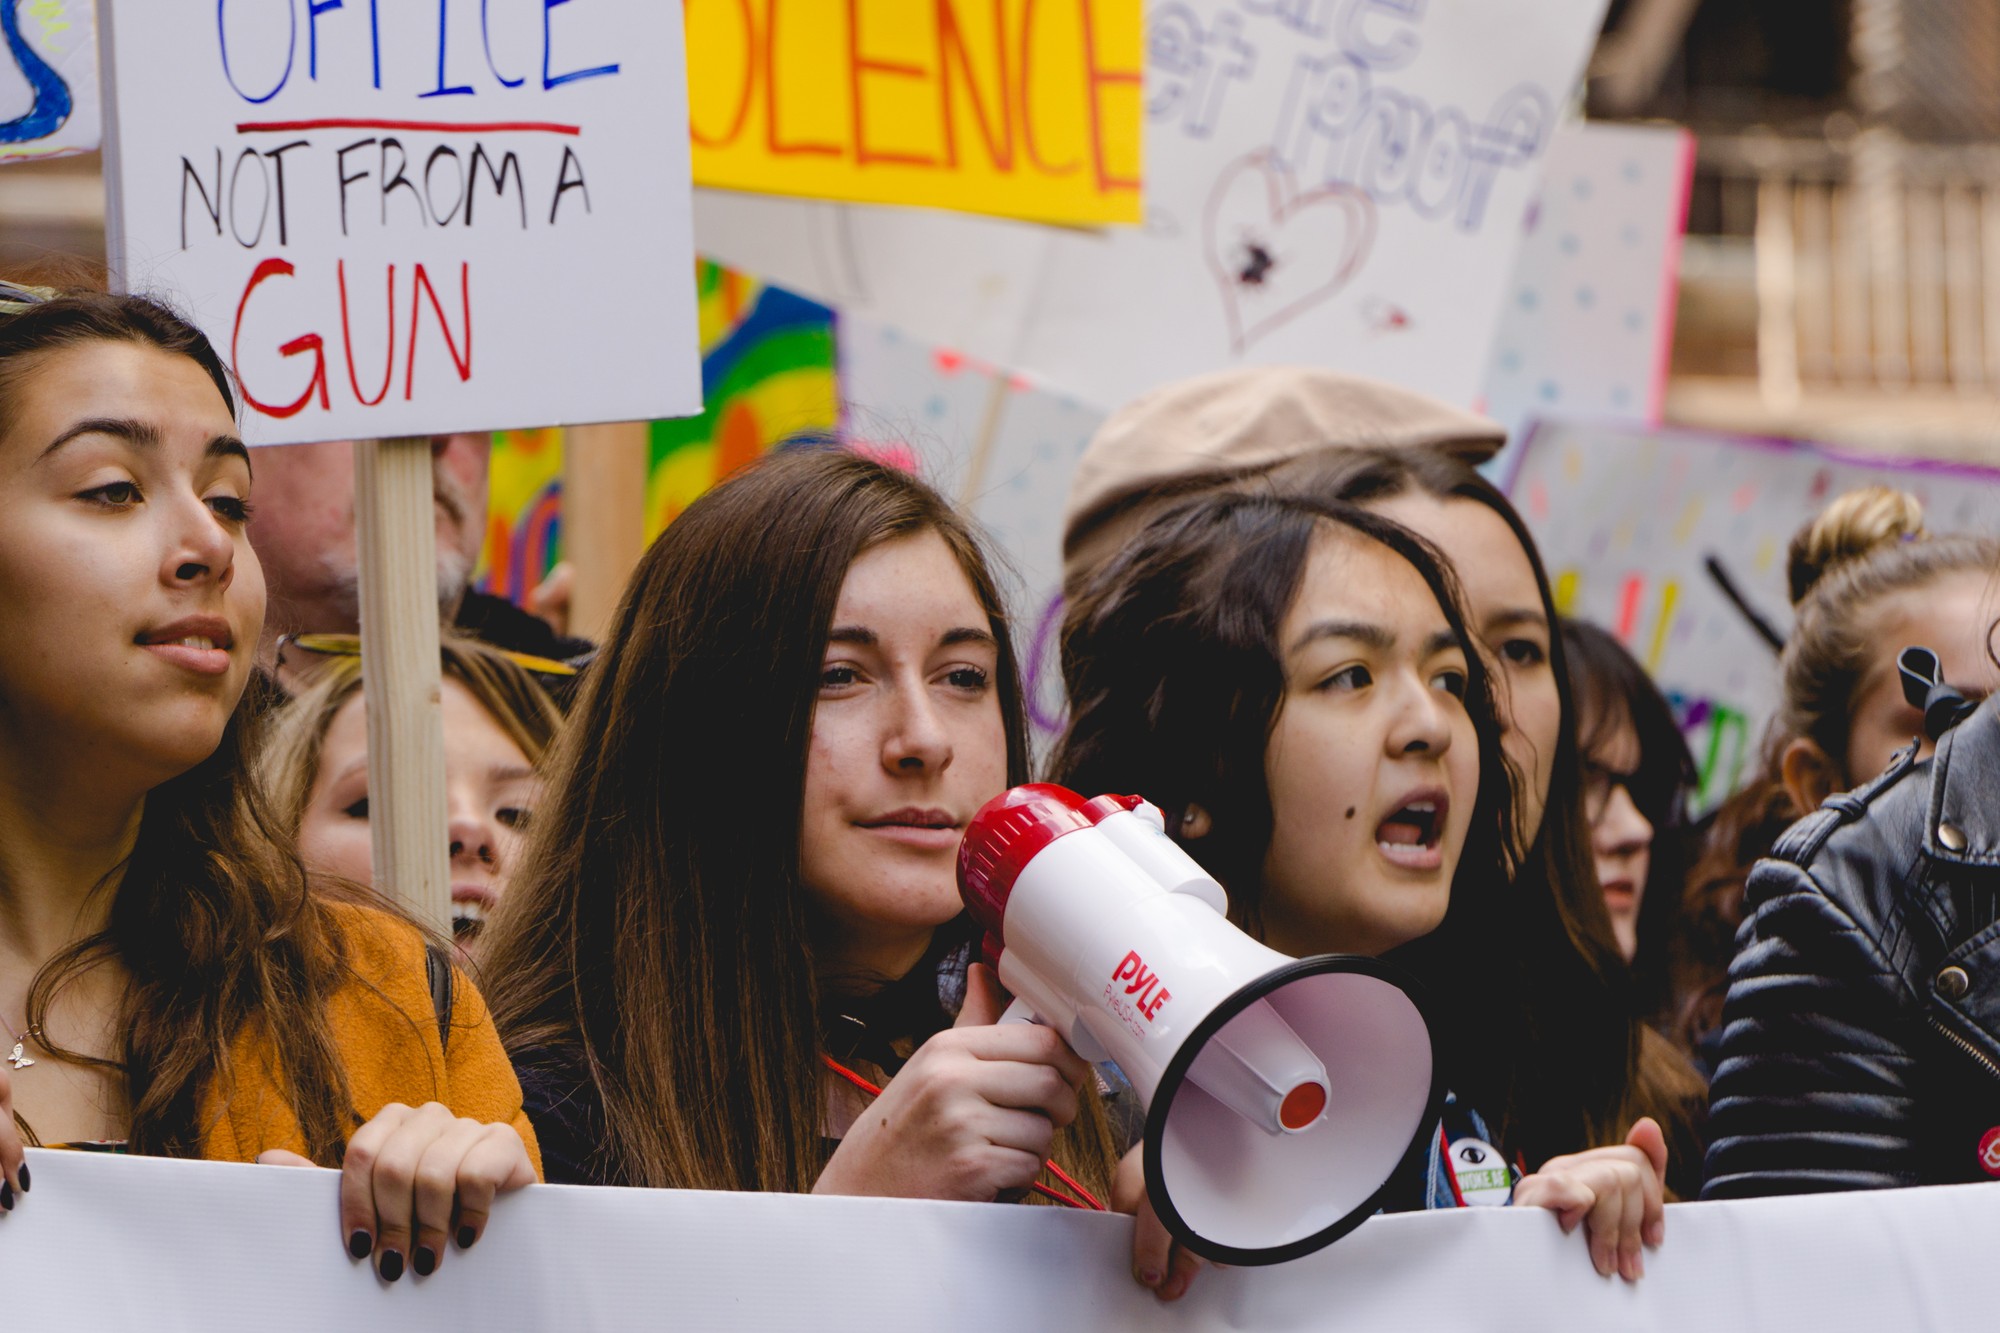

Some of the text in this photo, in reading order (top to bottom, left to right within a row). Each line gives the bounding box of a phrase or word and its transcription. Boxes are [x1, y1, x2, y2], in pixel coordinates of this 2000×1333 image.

[180, 137, 591, 250] NOT FROM A
[232, 258, 471, 418] GUN
[1111, 950, 1172, 1022] PYLE
